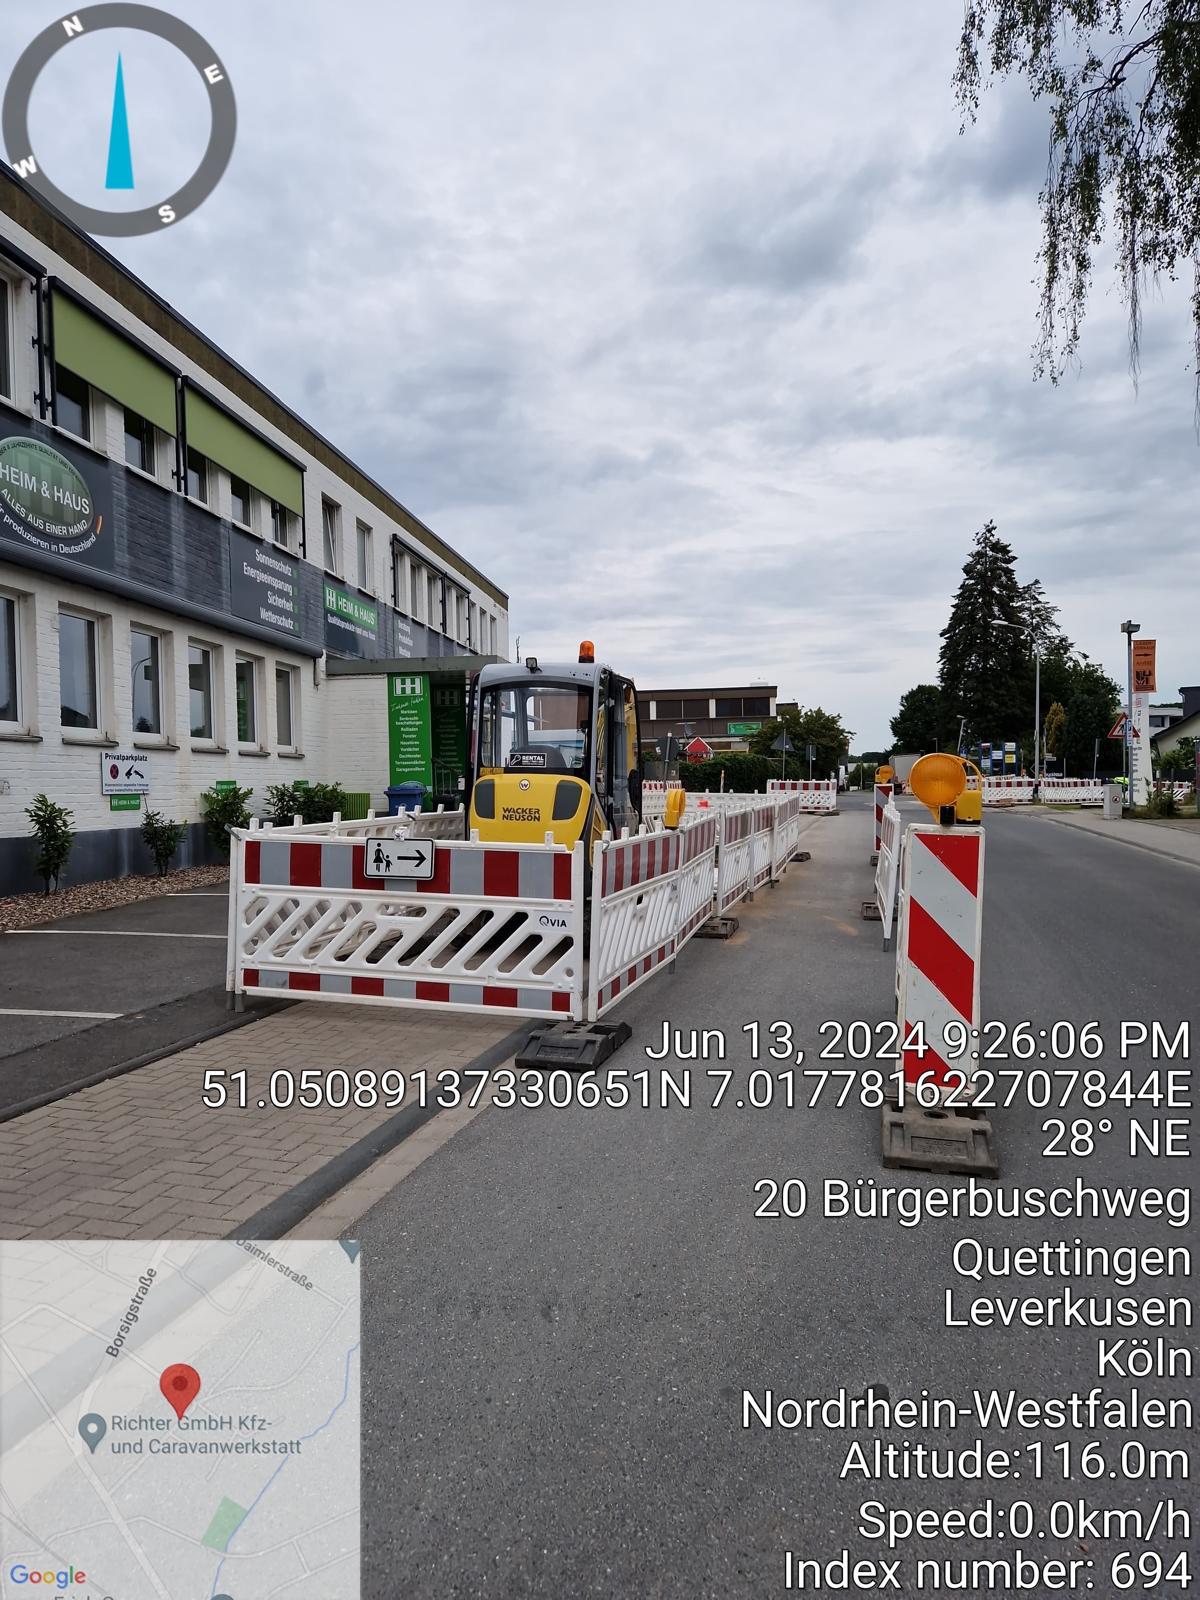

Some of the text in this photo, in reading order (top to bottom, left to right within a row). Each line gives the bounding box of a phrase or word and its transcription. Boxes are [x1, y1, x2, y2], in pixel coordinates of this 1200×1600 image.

[0, 462, 37, 493] HEIM
[40, 480, 51, 499] &
[54, 485, 90, 515] HAUS
[1, 488, 26, 518] ALLES
[27, 513, 44, 530] AUS
[45, 522, 67, 536] EINER
[68, 519, 88, 536] HAND
[3, 514, 97, 554] produzieren in Deutschland
[255, 548, 292, 577] Sonnenschutz
[243, 561, 293, 597] Energieeinsparung
[267, 590, 294, 612] Sicherheit
[337, 596, 375, 625] HEIM & HAUS
[259, 606, 294, 630] Wetterschutz
[104, 752, 148, 762] Privatparkplatz
[502, 807, 541, 815] WACKER
[502, 814, 541, 822] NEUSON
